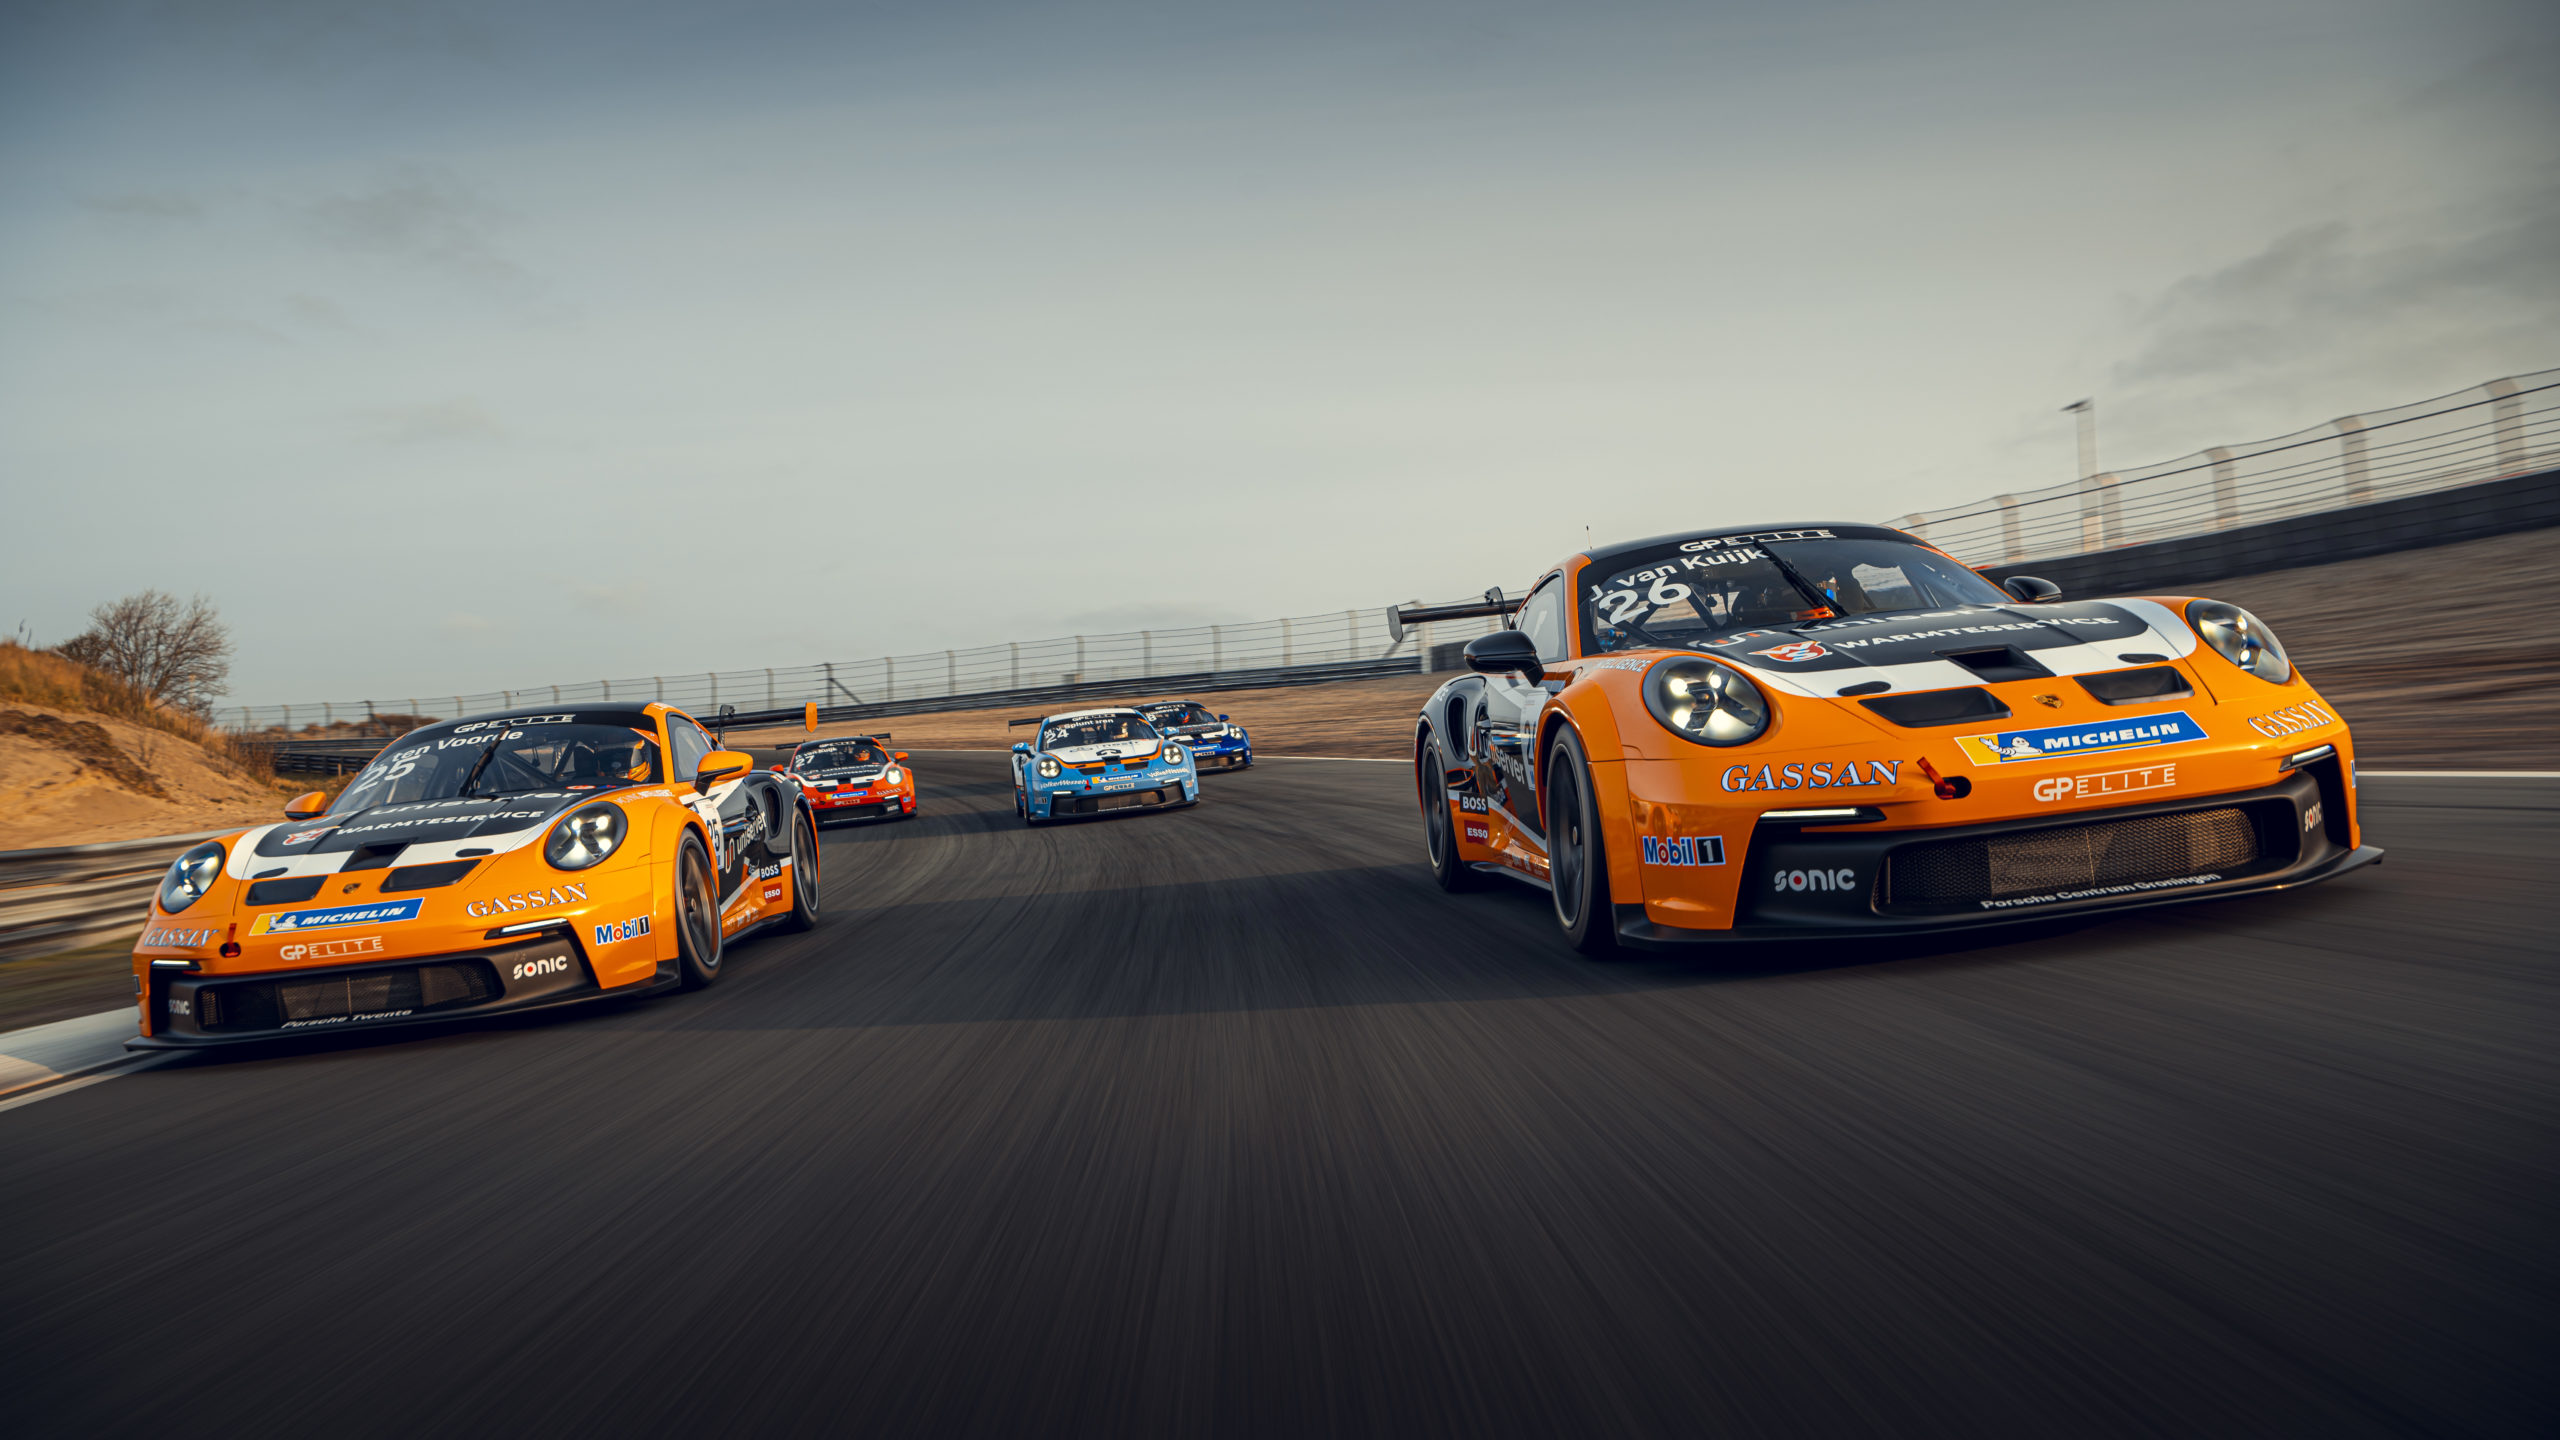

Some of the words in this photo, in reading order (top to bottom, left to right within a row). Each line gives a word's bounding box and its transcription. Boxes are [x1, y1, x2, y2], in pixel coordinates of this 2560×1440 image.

[1616, 564, 1678, 587] van
[1680, 548, 1769, 570] Kuijk
[1598, 575, 1692, 625] 26
[1834, 617, 2119, 649] WARMTESERVICE
[2247, 699, 2335, 740] GASSAN
[1045, 729, 1069, 744] 24
[2043, 721, 2180, 750] MICHELIN
[392, 745, 431, 762] ten
[796, 755, 815, 768] 27
[352, 755, 421, 795] 25
[1720, 759, 1903, 793] GASSAN
[1462, 796, 1487, 812] BOSS
[337, 811, 544, 835] WARMTESERVICE
[1467, 827, 1488, 839] ESSO
[1643, 835, 1694, 866] Mobil
[760, 864, 779, 879] BOSS
[466, 882, 589, 918] GASSAN
[765, 888, 781, 899] ESSO
[1980, 893, 2057, 909] Porsche
[2056, 884, 2133, 900] Centrum
[2133, 872, 2222, 889] Groningen
[300, 905, 406, 927] MICHELIN
[144, 927, 219, 947] GASSAN
[595, 918, 638, 946] Mobil
[281, 1016, 348, 1029] Porsche
[352, 1009, 413, 1020] Twente
